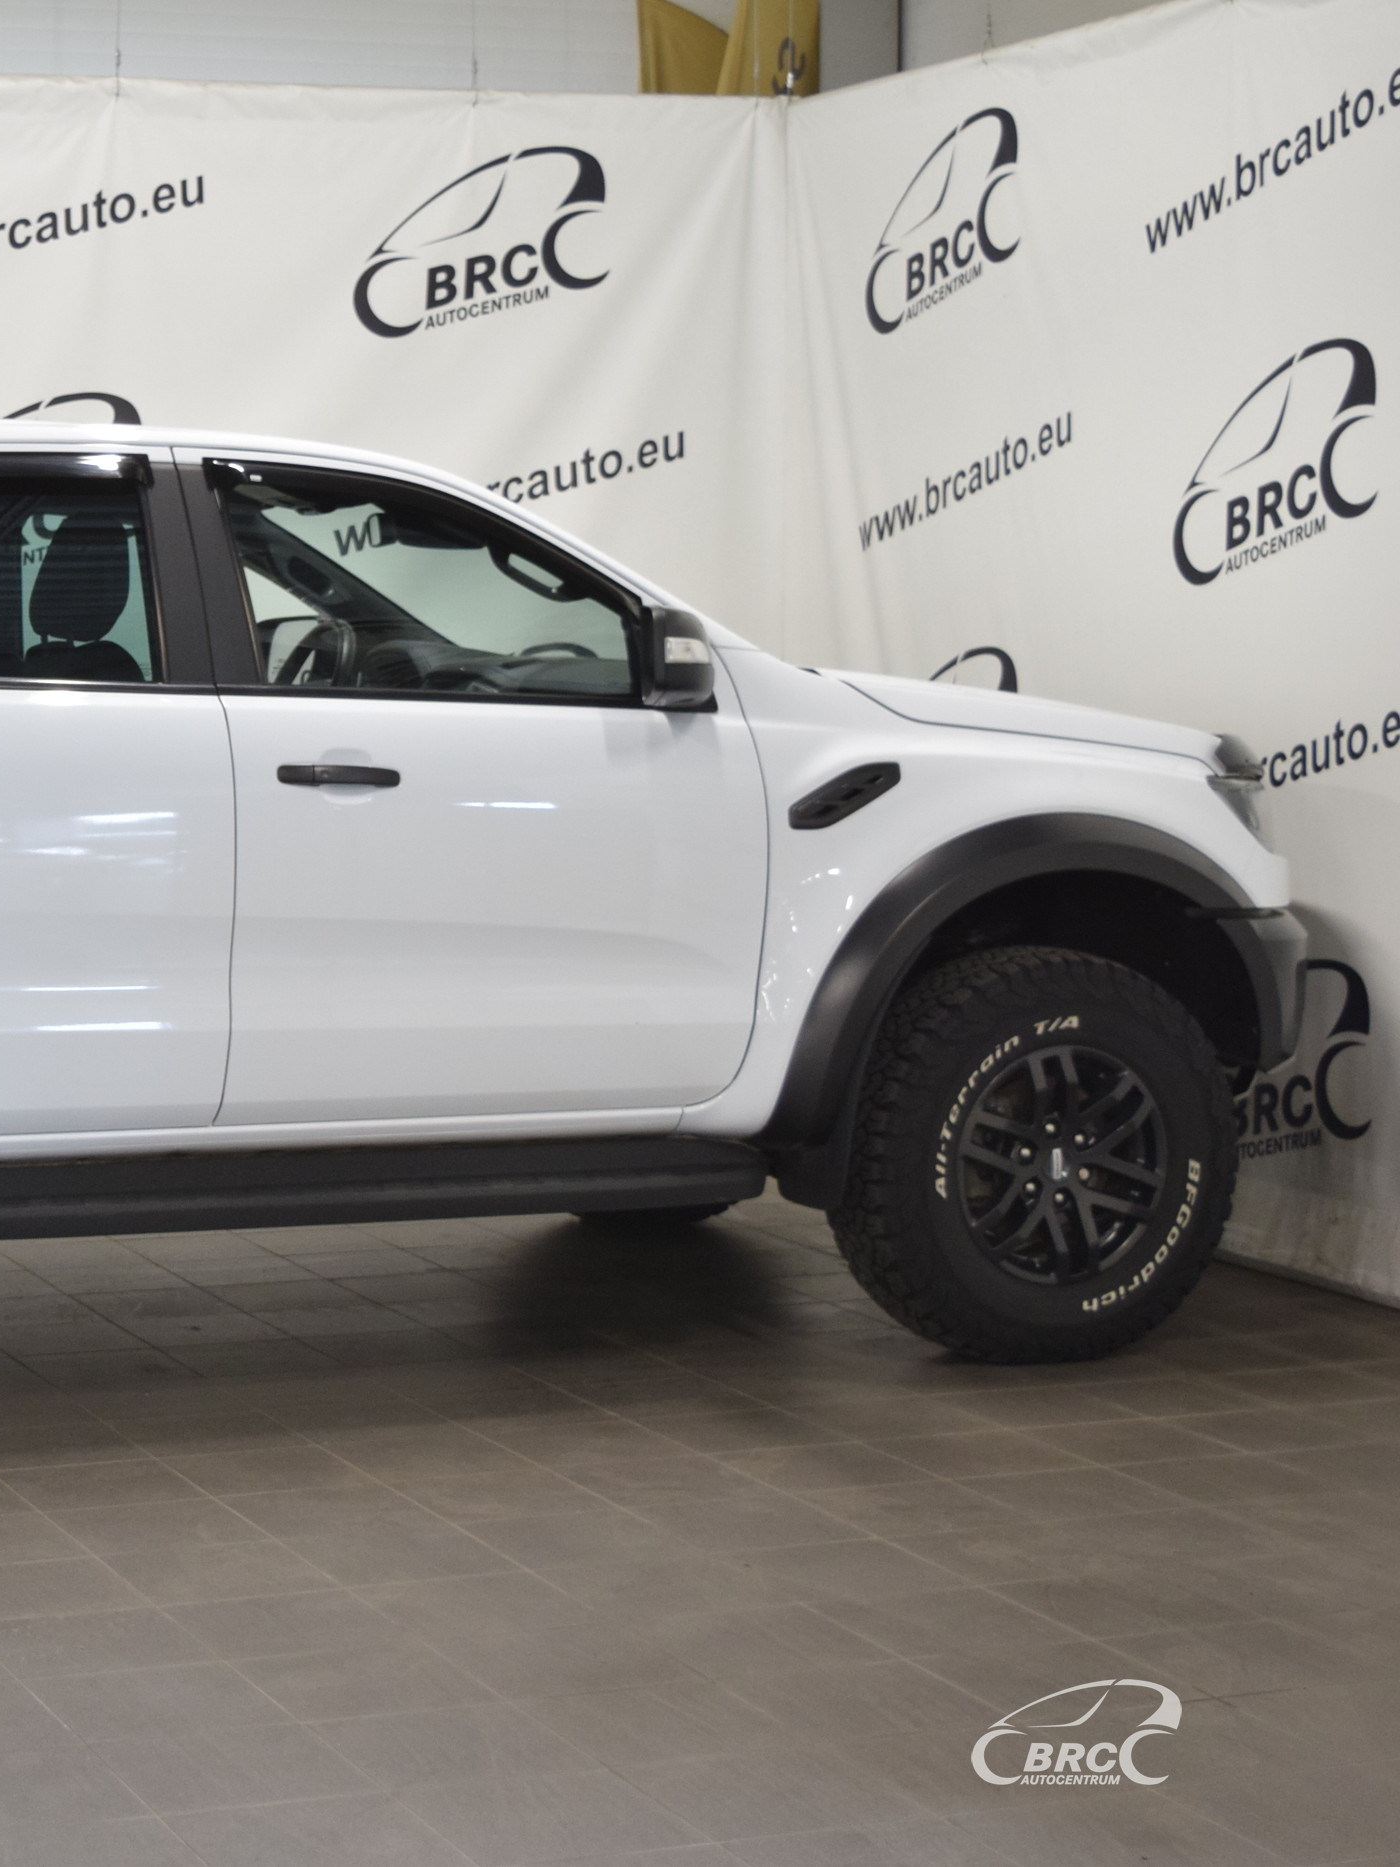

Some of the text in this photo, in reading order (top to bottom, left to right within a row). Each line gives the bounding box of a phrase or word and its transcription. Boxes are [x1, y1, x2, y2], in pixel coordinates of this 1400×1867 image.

[425, 244, 538, 310] BRC
[906, 219, 975, 301] BRC
[906, 262, 982, 321] AUTOCENTRUM
[425, 286, 549, 330] AUTOCENTRUM
[859, 411, 1073, 551] www.brcauto.eu
[1226, 464, 1317, 551] BRC
[1225, 515, 1326, 574] AUTOCENTRUM
[935, 1015, 1080, 1199] All-Terrain T/A
[1081, 1158, 1201, 1313] BFGoodrich
